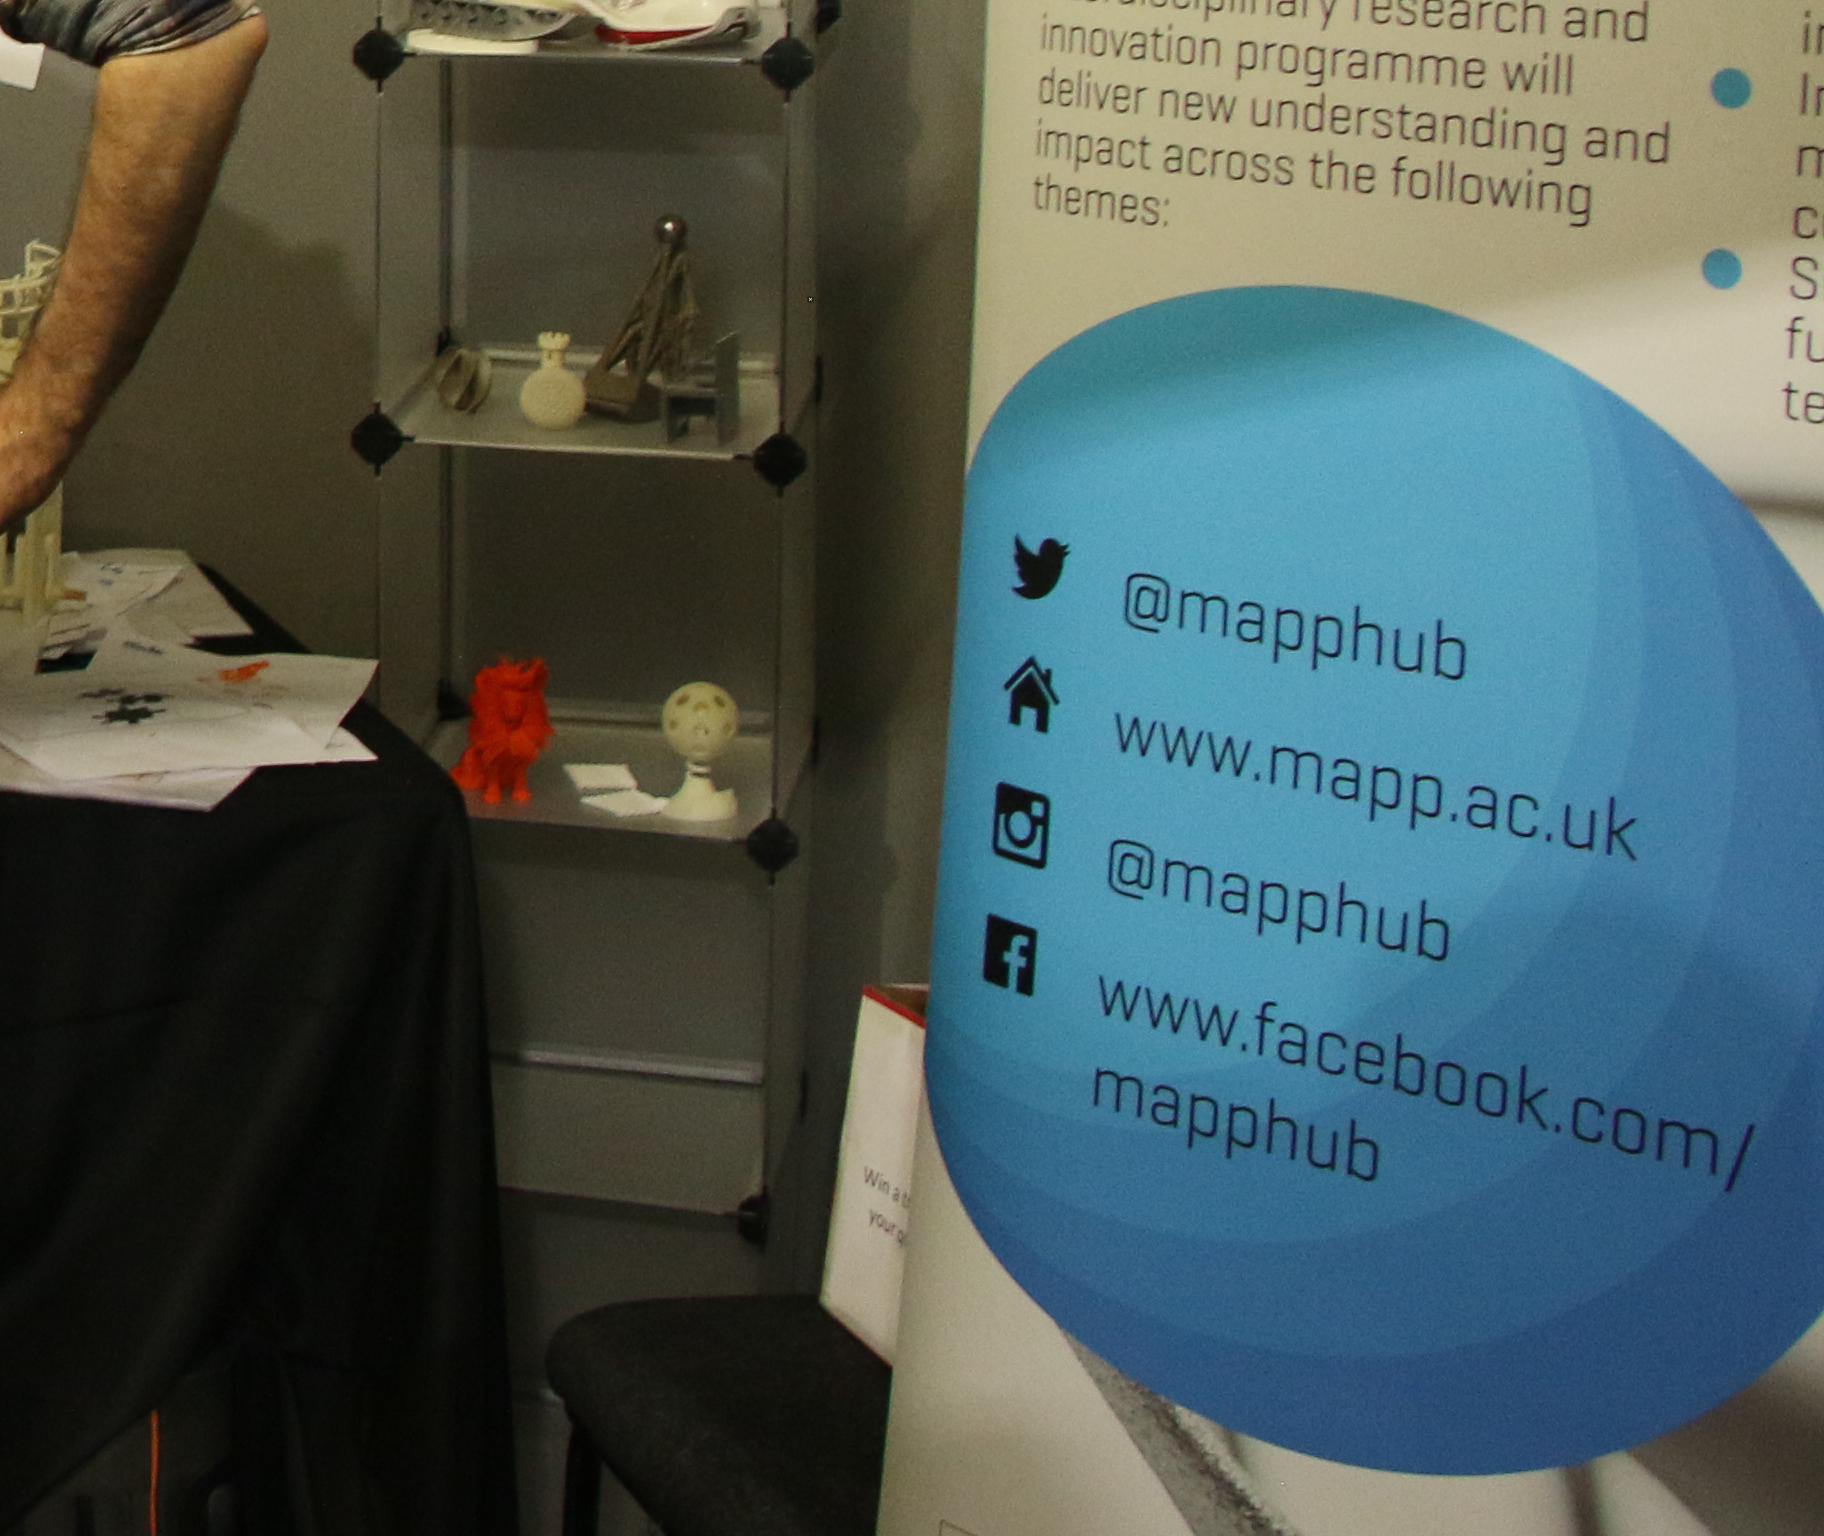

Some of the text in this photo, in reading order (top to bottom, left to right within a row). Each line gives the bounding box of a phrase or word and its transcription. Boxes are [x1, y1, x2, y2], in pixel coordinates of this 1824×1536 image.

[1041, 13, 1575, 96] innovation programme will
[1563, 0, 1650, 43] and
[1039, 67, 1671, 166] deliver new understanding and
[1033, 173, 1169, 228] themes:
[1035, 119, 1593, 228] impact across the following
[1123, 573, 1466, 680] @mapphub
[1115, 710, 1638, 861] www.mapp.ac.uk
[1108, 838, 1450, 961] @mapphub
[1093, 1068, 1380, 1181] mapphub
[1098, 975, 1754, 1191] www.facebook.com/
[864, 1165, 890, 1195] Win
[869, 1210, 897, 1236] your
